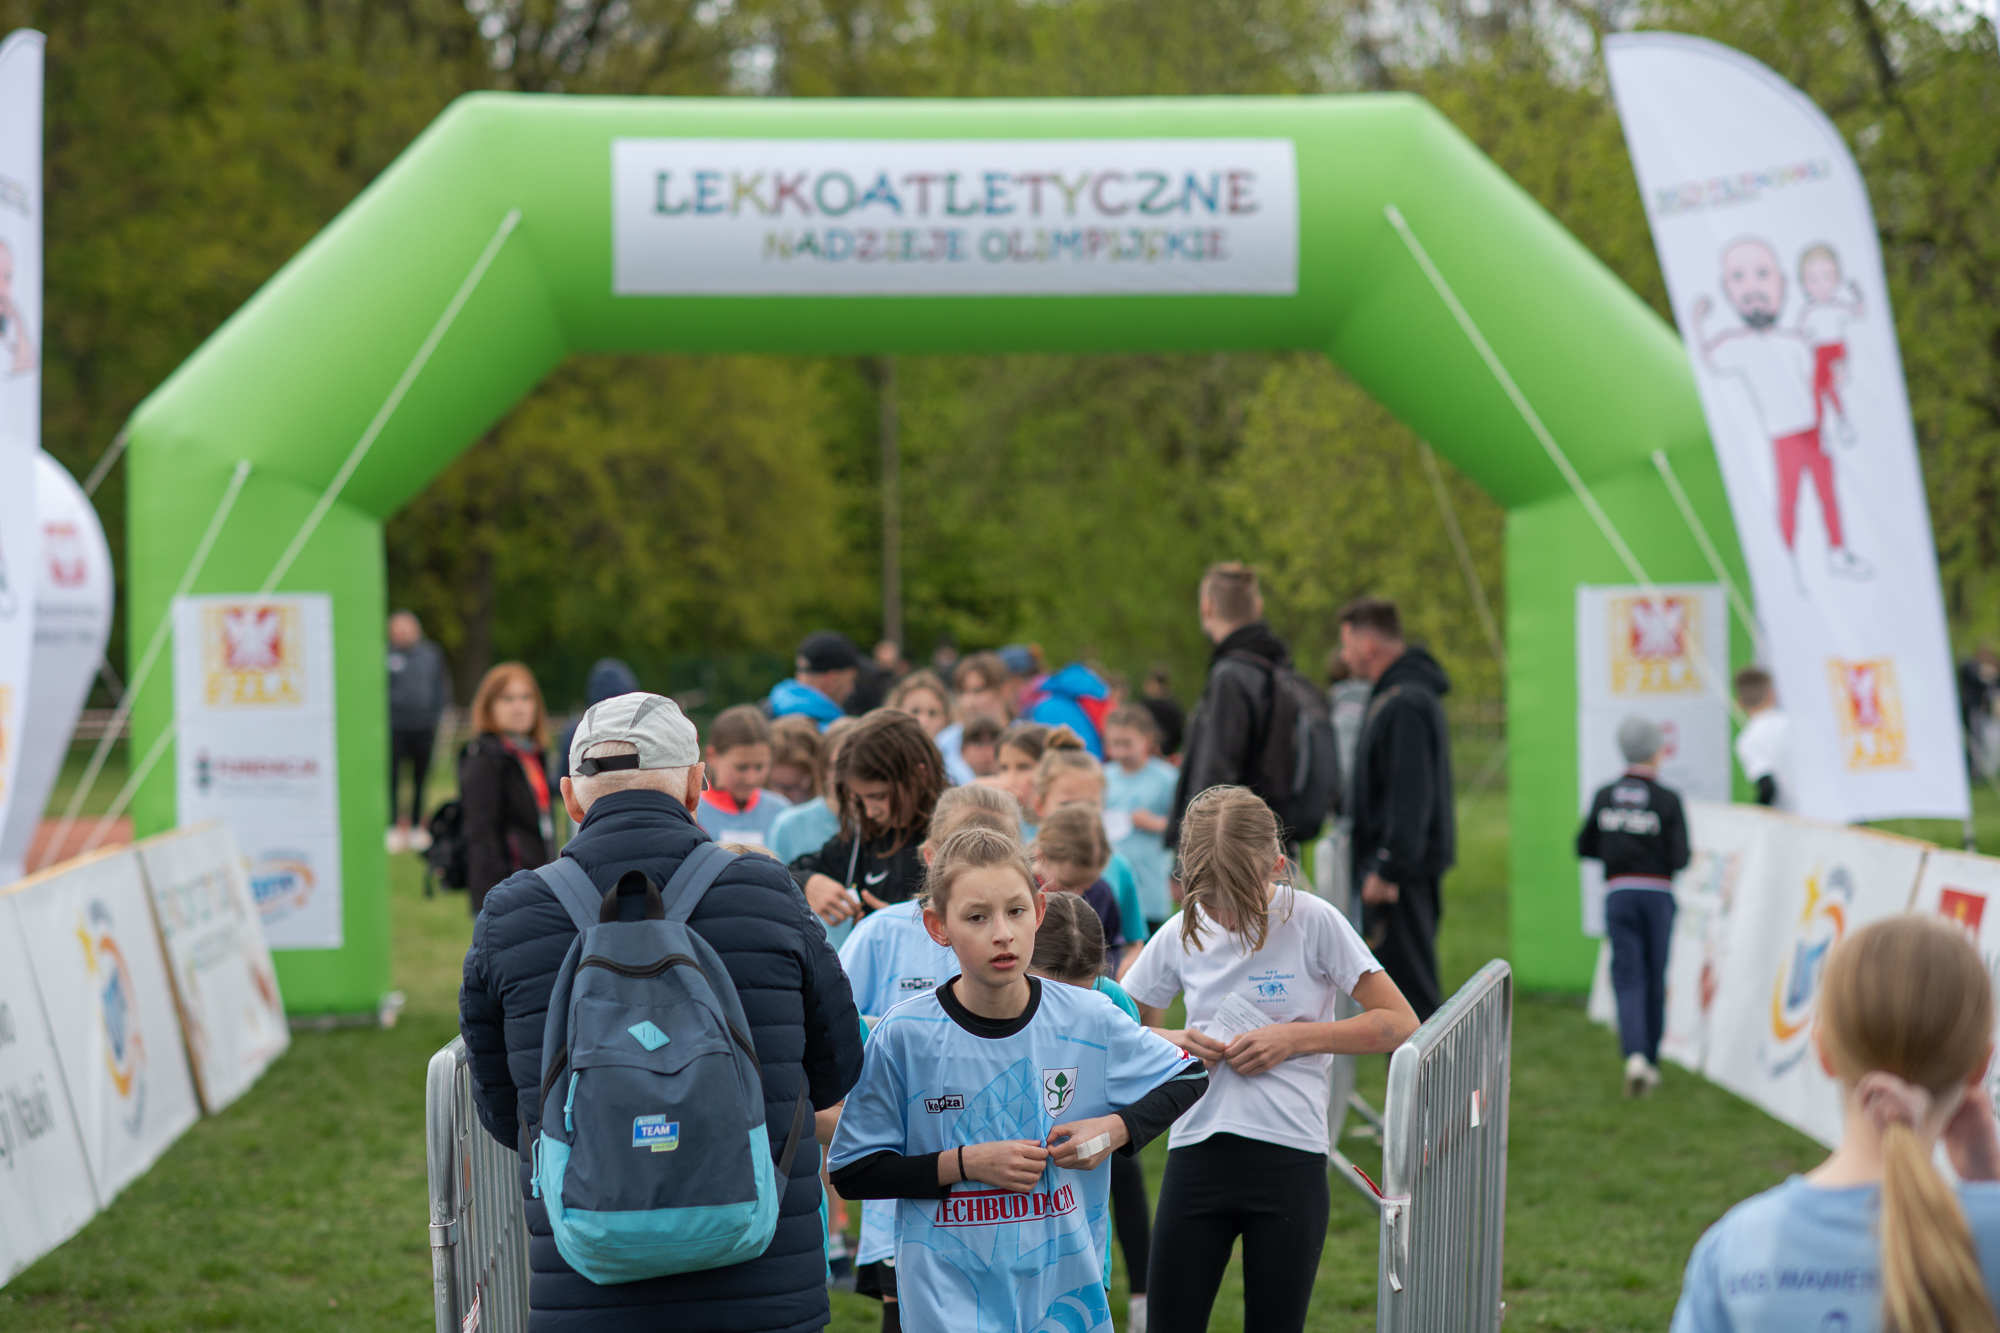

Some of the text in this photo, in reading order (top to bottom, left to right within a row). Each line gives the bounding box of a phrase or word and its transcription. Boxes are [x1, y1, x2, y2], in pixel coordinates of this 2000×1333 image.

[654, 171, 1260, 217] LEKKOATLETYCZNE
[763, 228, 968, 262] NADZIEJE
[641, 1125, 670, 1136] TEAM
